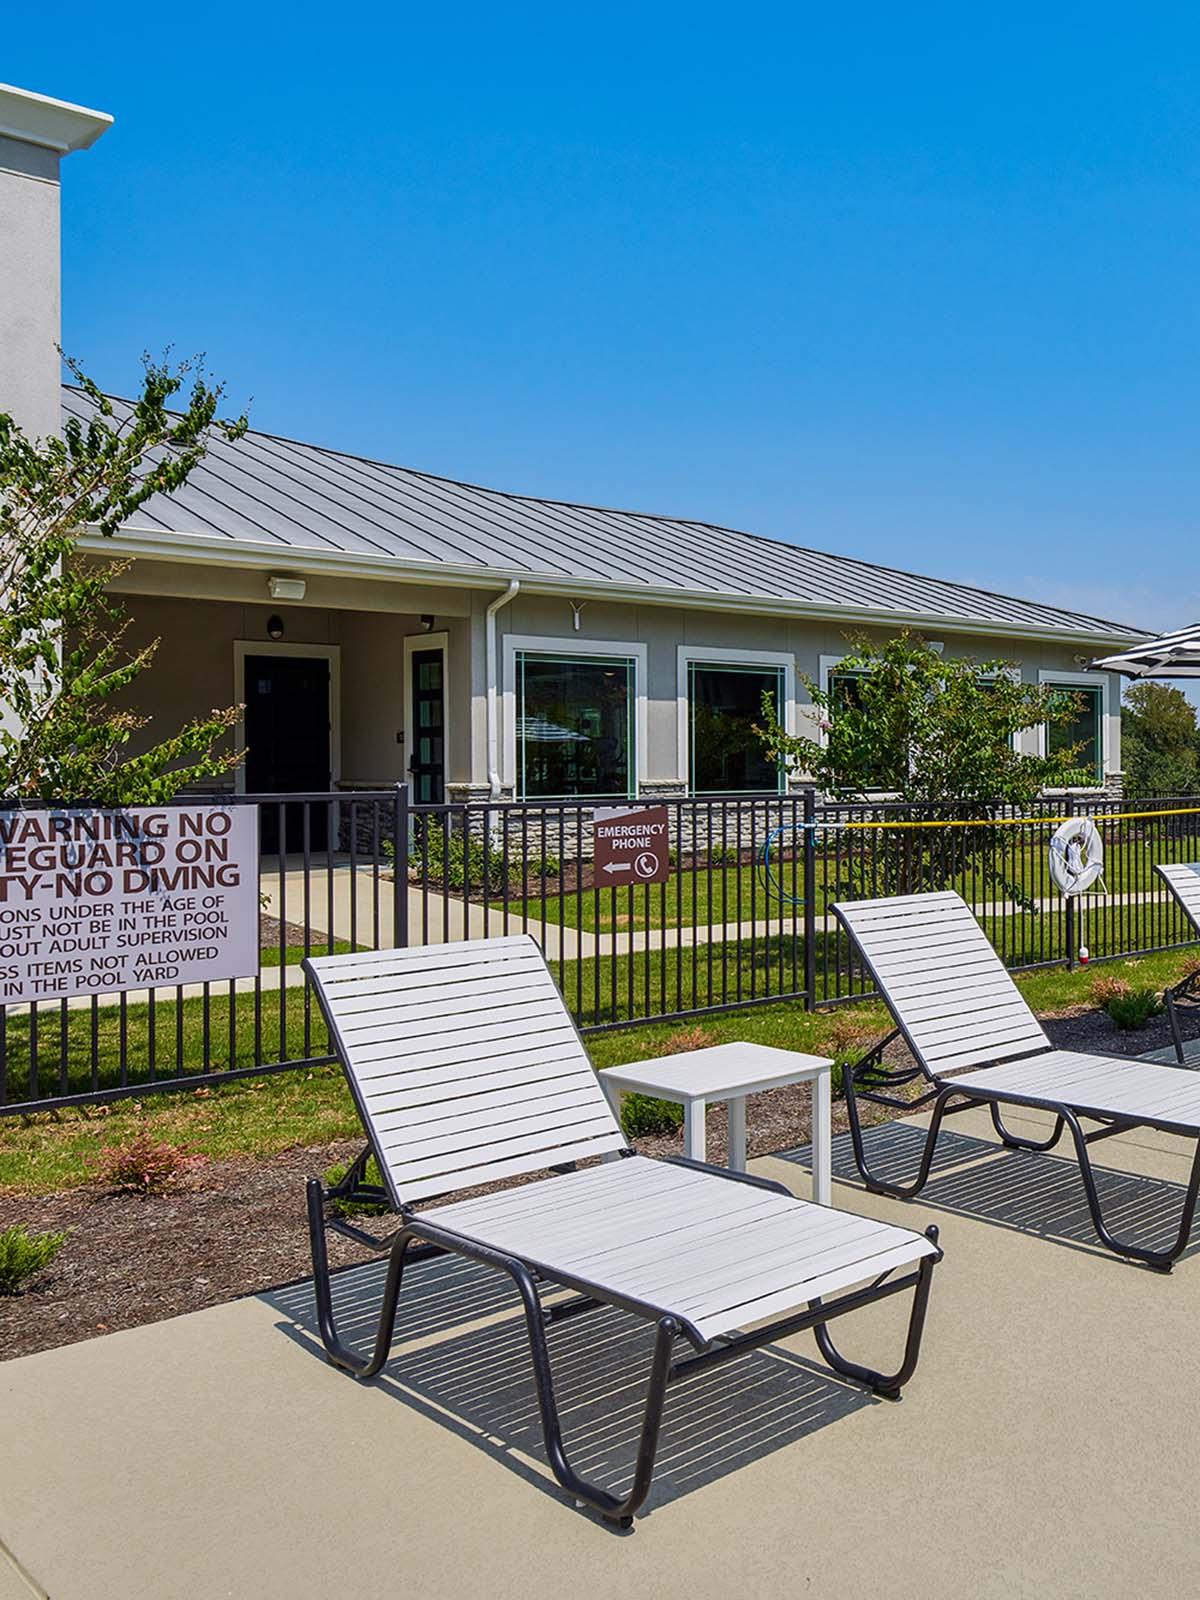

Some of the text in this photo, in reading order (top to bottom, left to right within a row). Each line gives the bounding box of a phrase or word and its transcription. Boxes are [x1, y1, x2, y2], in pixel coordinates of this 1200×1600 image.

[179, 812, 232, 838] NO
[597, 824, 665, 838] EMERGENCY
[175, 838, 228, 864] ON
[612, 837, 651, 850] PHONE
[123, 863, 240, 894] DIVING
[0, 895, 224, 924] ONS UNDER THE AGE OF
[42, 921, 82, 938] NOT
[90, 919, 112, 933] BE
[119, 917, 136, 931] IN
[143, 914, 177, 929] THE
[184, 911, 229, 926] POOL
[0, 926, 227, 958] OUT ADULT SUPERVISION
[27, 959, 82, 977] ITEMS
[91, 955, 128, 971] NOT
[136, 946, 218, 966] ALLOWED
[4, 966, 179, 996] IN THE POOL YARD
